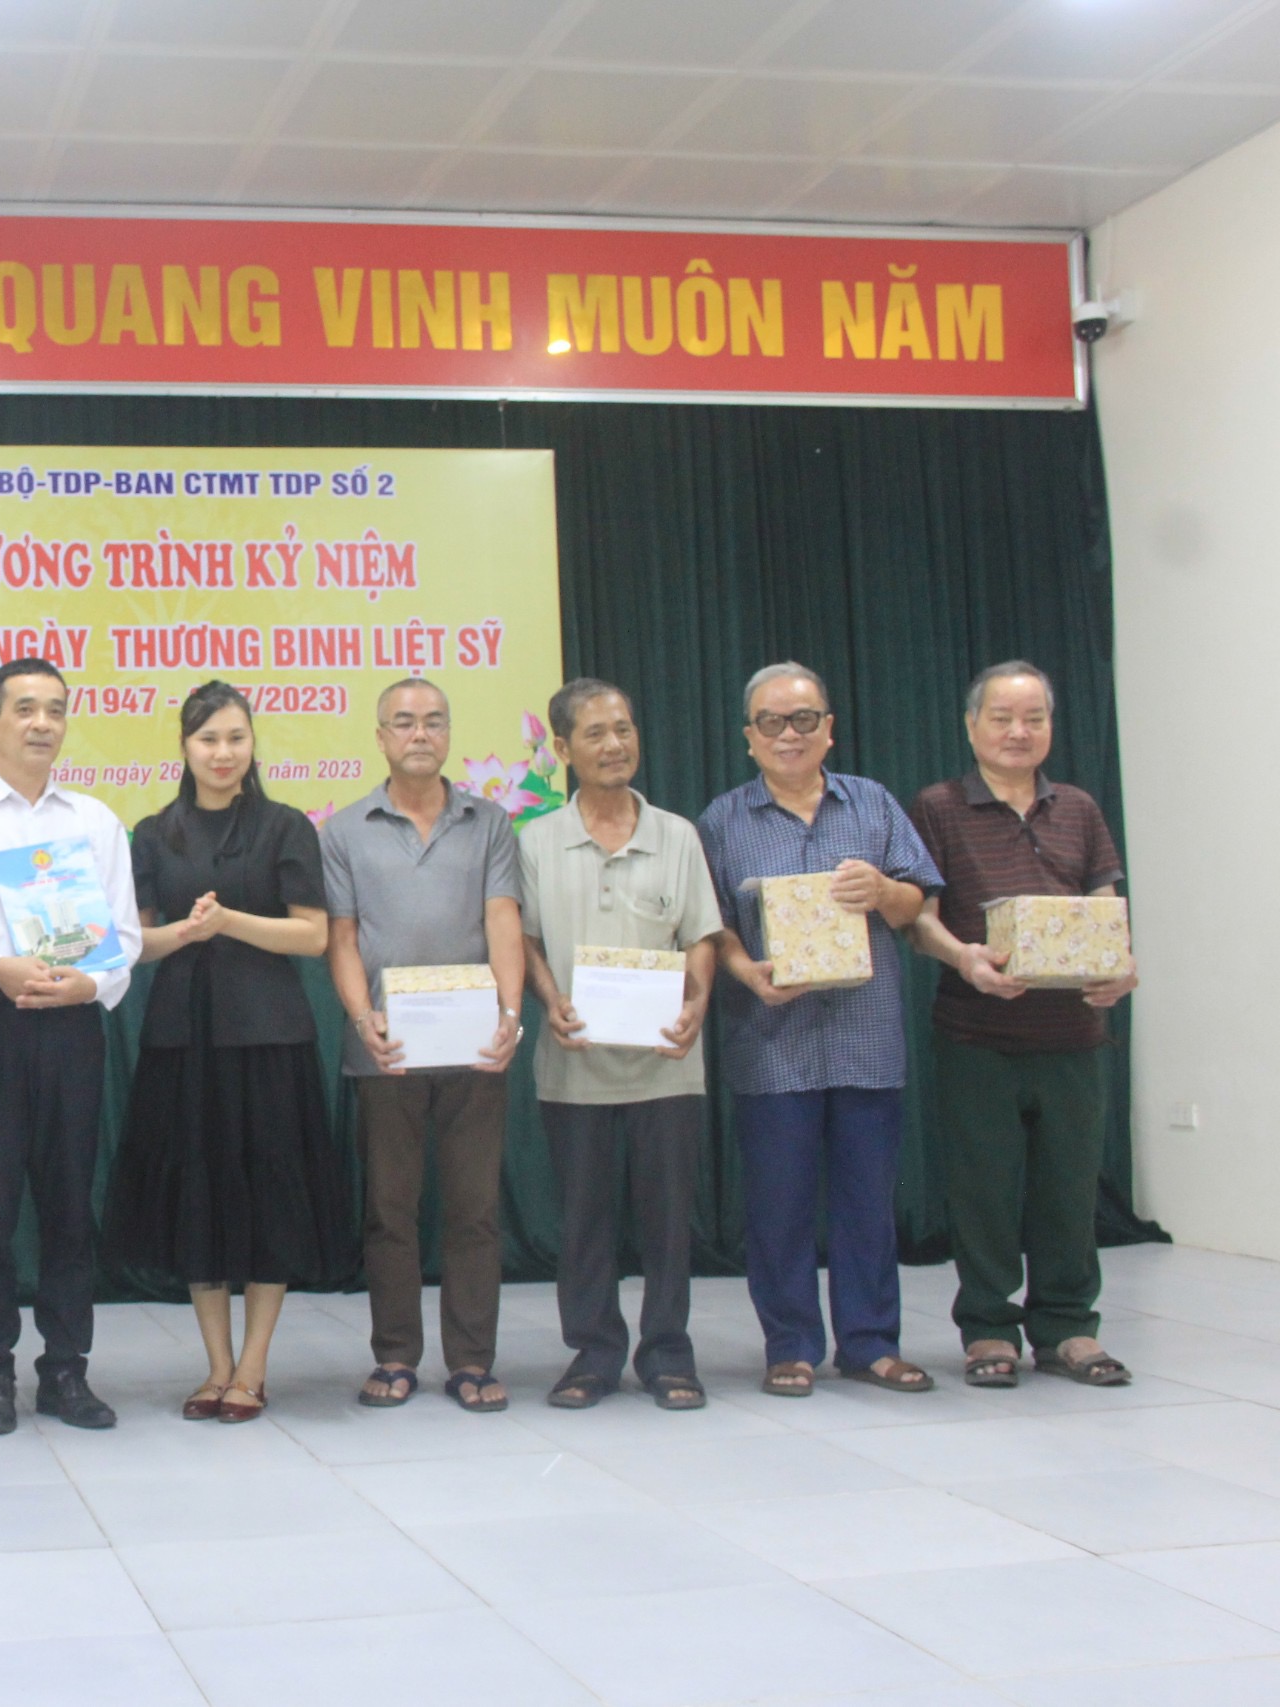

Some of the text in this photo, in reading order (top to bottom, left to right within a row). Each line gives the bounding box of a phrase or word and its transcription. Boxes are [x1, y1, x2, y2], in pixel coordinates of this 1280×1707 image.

[313, 266, 512, 352] VINH
[546, 258, 785, 358] MUÔN
[821, 263, 1005, 362] NĂM
[184, 472, 260, 496] CTMT
[269, 473, 322, 496] TDP
[332, 465, 369, 496] SỐ
[377, 473, 394, 496] 2
[103, 529, 234, 588] TRÌNH
[245, 524, 304, 588] KỶ
[315, 529, 417, 601] NIỆM
[111, 624, 261, 668] THƯƠNG
[273, 628, 361, 667] BINH
[374, 619, 446, 675] LIỆT
[458, 619, 502, 667] SỸ
[103, 761, 152, 786] ngày
[268, 762, 310, 779] năm
[317, 760, 362, 779] 2023
